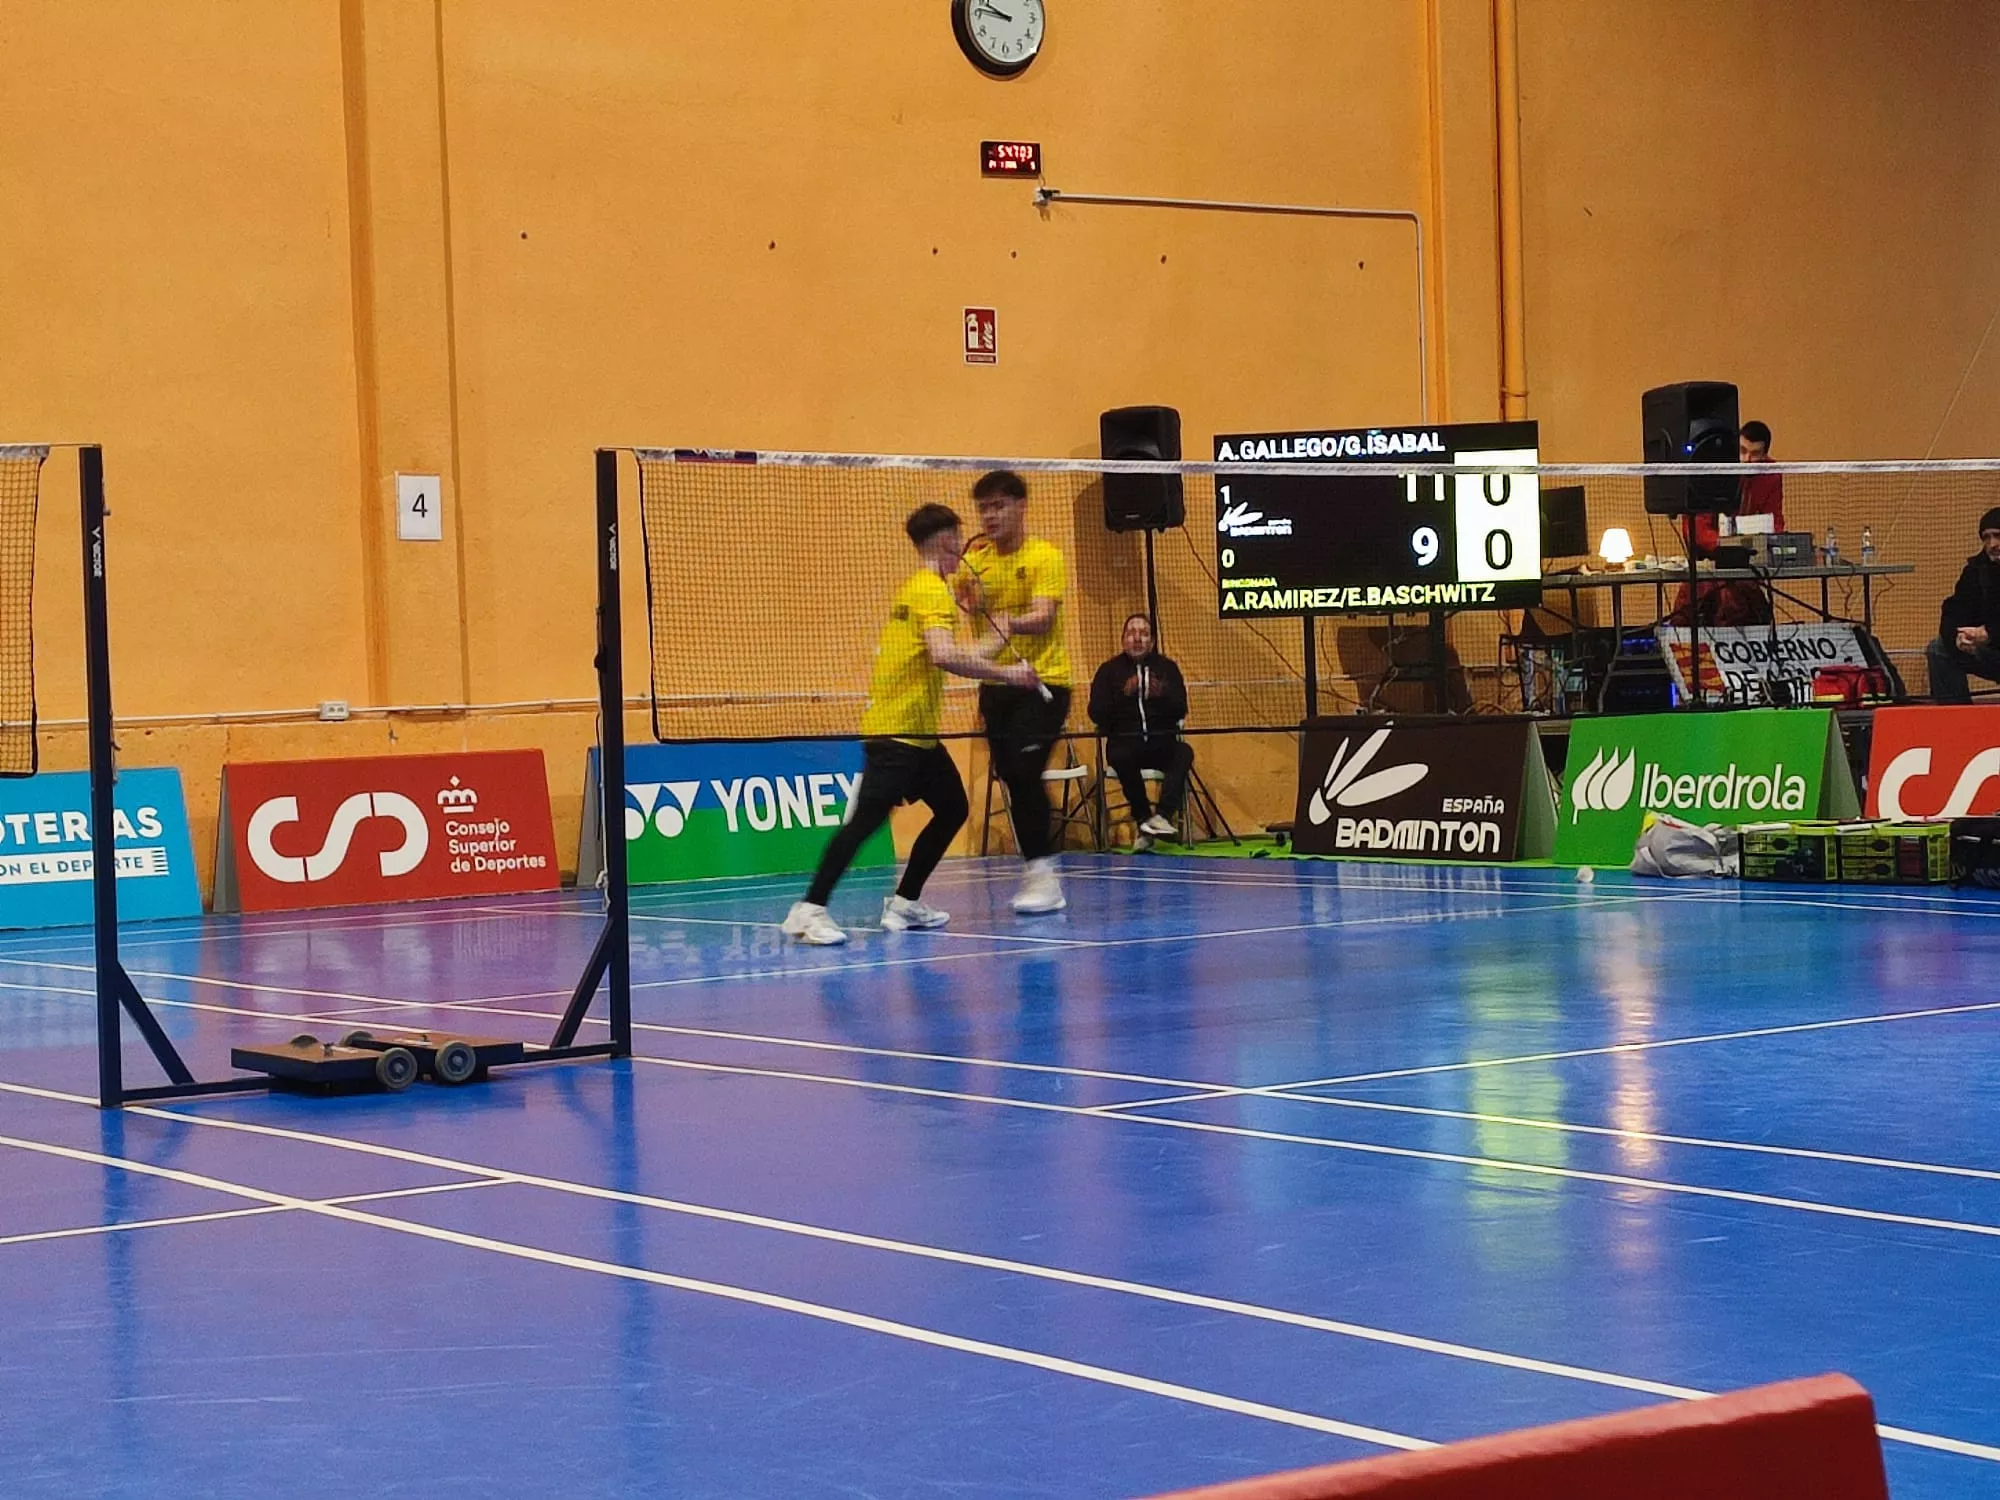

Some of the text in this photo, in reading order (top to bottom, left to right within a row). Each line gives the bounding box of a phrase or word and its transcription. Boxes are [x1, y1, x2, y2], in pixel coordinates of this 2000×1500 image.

[411, 492, 429, 519] 4
[1219, 485, 1231, 505] 1
[1221, 548, 1235, 569] 0
[1411, 526, 1440, 567] 9
[1483, 528, 1514, 570] 0
[1639, 763, 1806, 811] Iberdrola
[0, 806, 163, 845] TERAS
[445, 817, 511, 839] Consejo
[1335, 817, 1501, 854] BADMINTON
[448, 838, 517, 857] Superior
[29, 861, 51, 875] EL
[57, 856, 144, 873] DEPRTE
[450, 854, 546, 875] de Deportes
